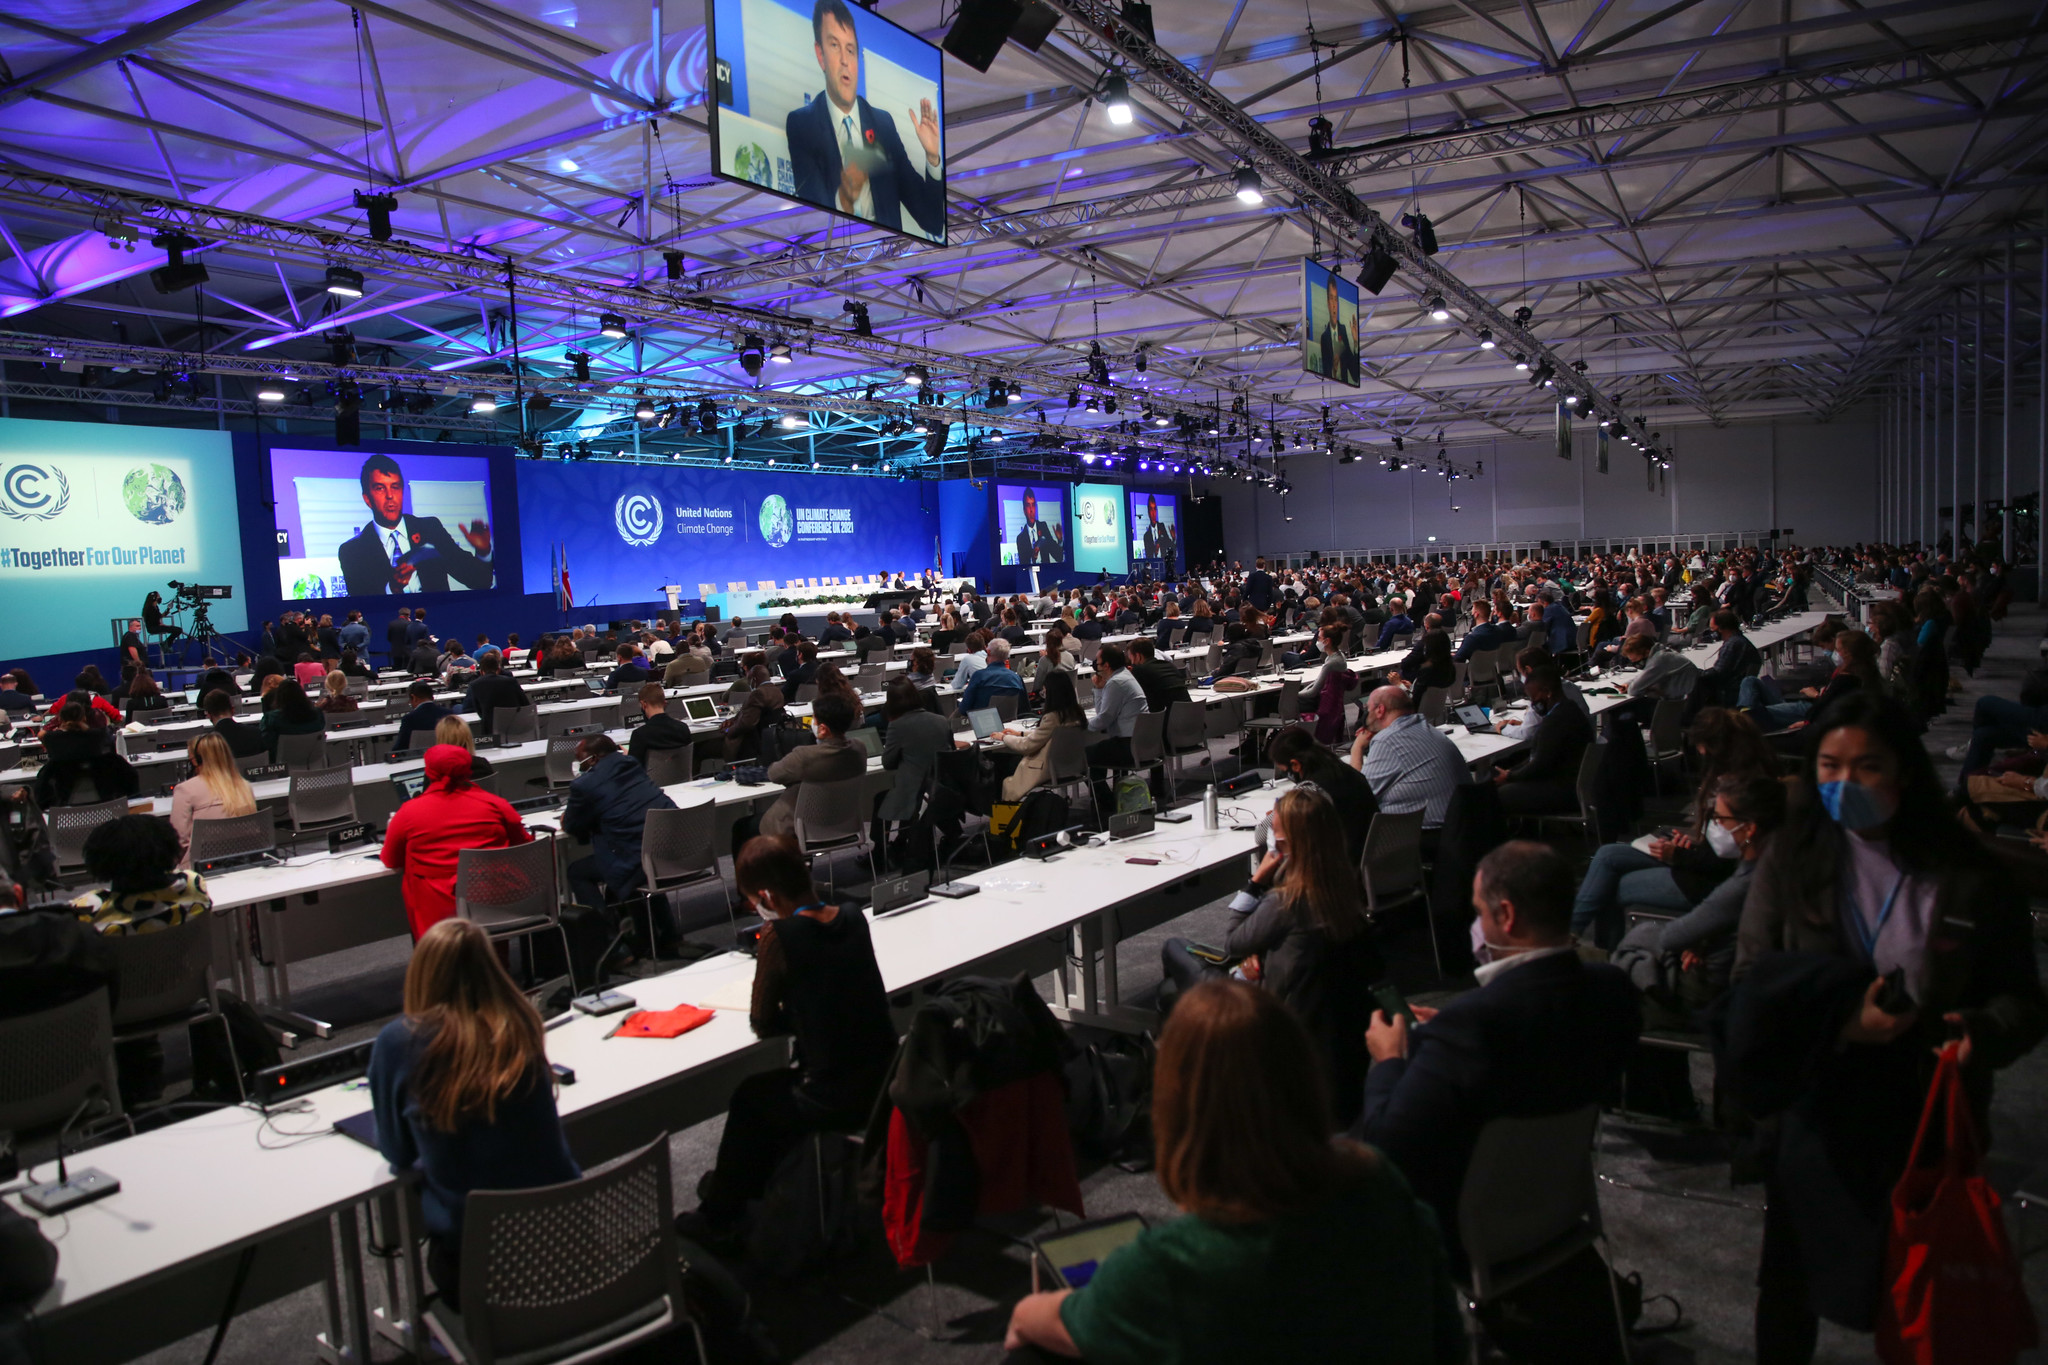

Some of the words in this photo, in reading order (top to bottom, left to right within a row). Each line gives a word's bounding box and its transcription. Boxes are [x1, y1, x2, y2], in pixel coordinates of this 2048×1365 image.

[676, 507, 702, 518] United
[703, 507, 732, 519] Nations
[796, 508, 805, 520] UN
[805, 508, 829, 521] CLIMATE
[829, 508, 851, 521] CHANGE
[677, 523, 705, 534] Climate
[706, 524, 733, 537] Change
[797, 521, 833, 534] CONFERENCE
[833, 521, 841, 534] UK
[841, 521, 854, 534] 2021
[0, 546, 186, 571] #TogetherForOurPlanet
[474, 736, 494, 745] EMEN
[247, 767, 264, 776] VIET
[268, 764, 286, 773] NAM
[1126, 813, 1140, 825] ITU
[340, 826, 365, 841] ICRAF
[893, 880, 909, 895] IFC
